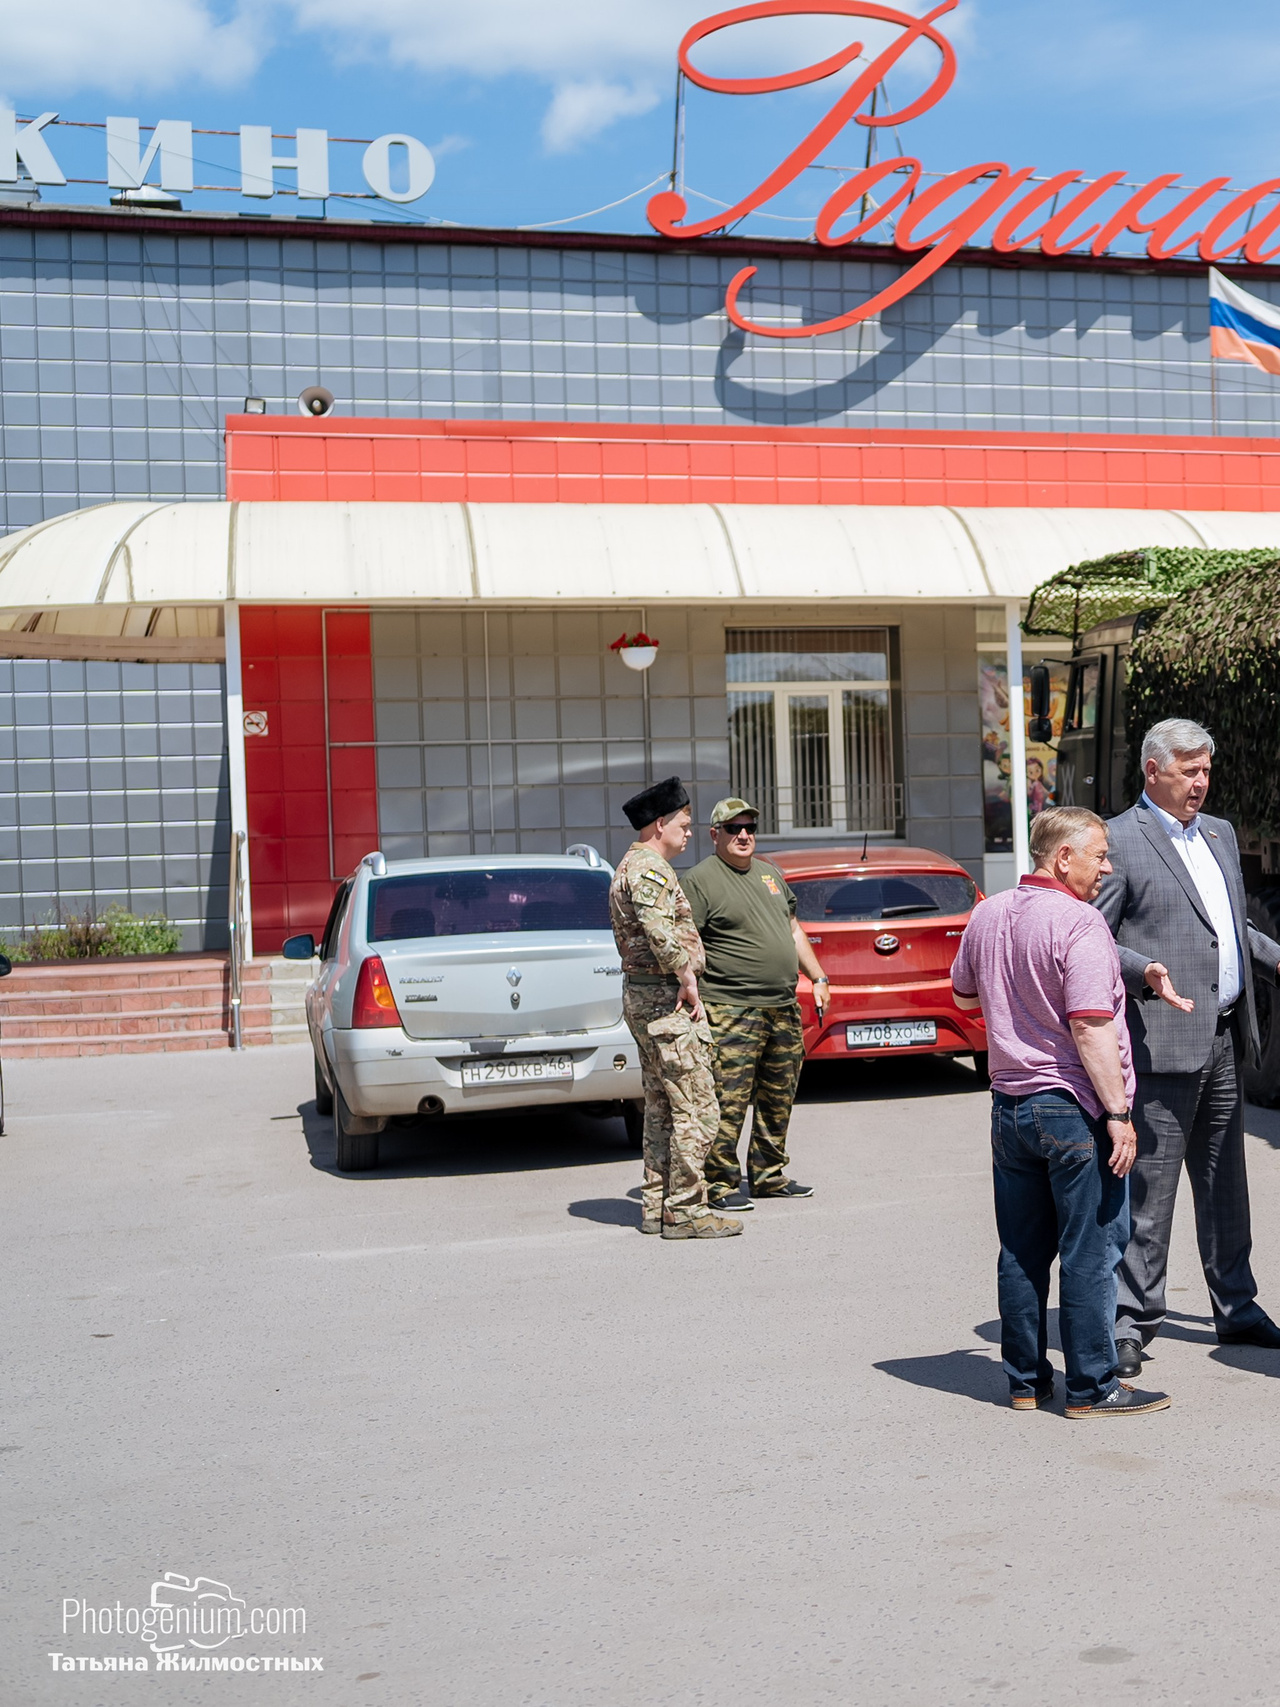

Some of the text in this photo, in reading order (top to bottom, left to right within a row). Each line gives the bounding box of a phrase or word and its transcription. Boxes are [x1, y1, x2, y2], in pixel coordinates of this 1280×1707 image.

[0, 109, 436, 204] КИНО
[917, 1022, 931, 1034] 46
[549, 1056, 566, 1071] 46
